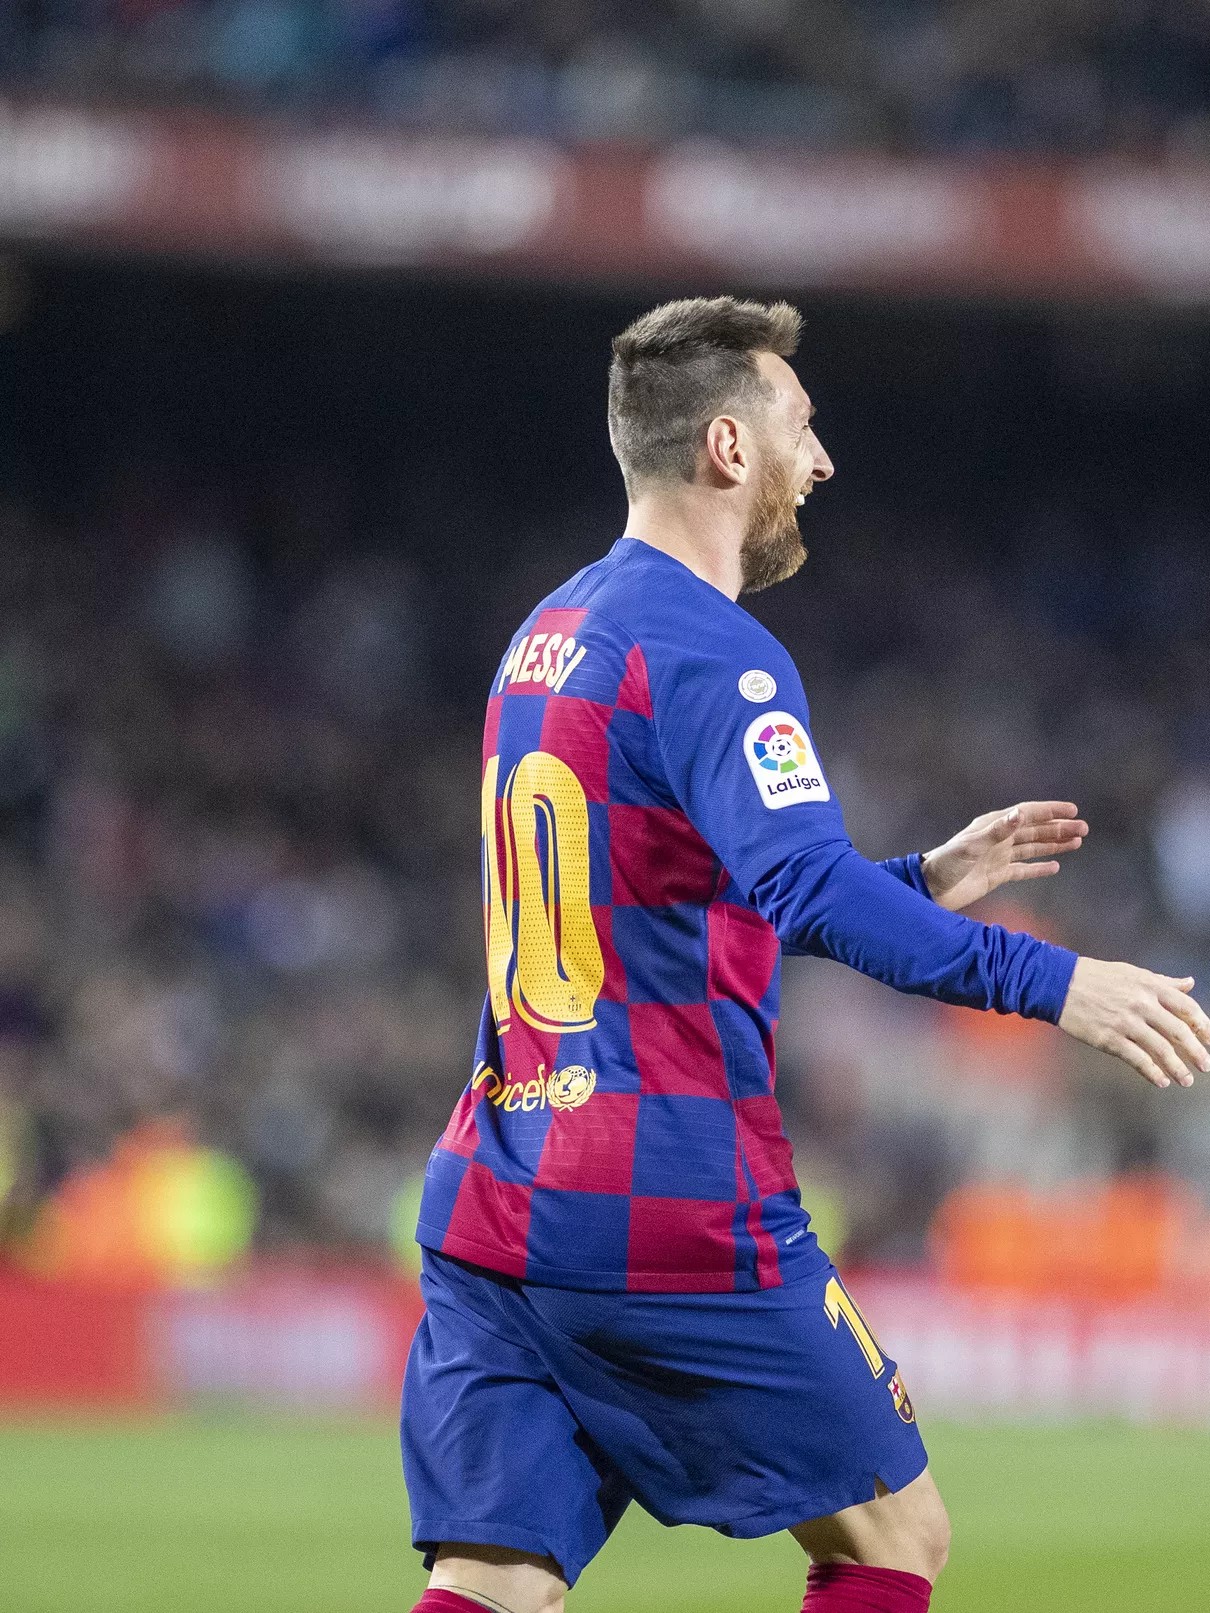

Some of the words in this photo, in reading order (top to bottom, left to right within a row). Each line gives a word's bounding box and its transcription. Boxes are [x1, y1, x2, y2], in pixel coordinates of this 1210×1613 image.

[497, 633, 587, 694] MESSI
[767, 774, 821, 796] LaLiga
[482, 751, 605, 1036] 10
[823, 1276, 888, 1379] 1
